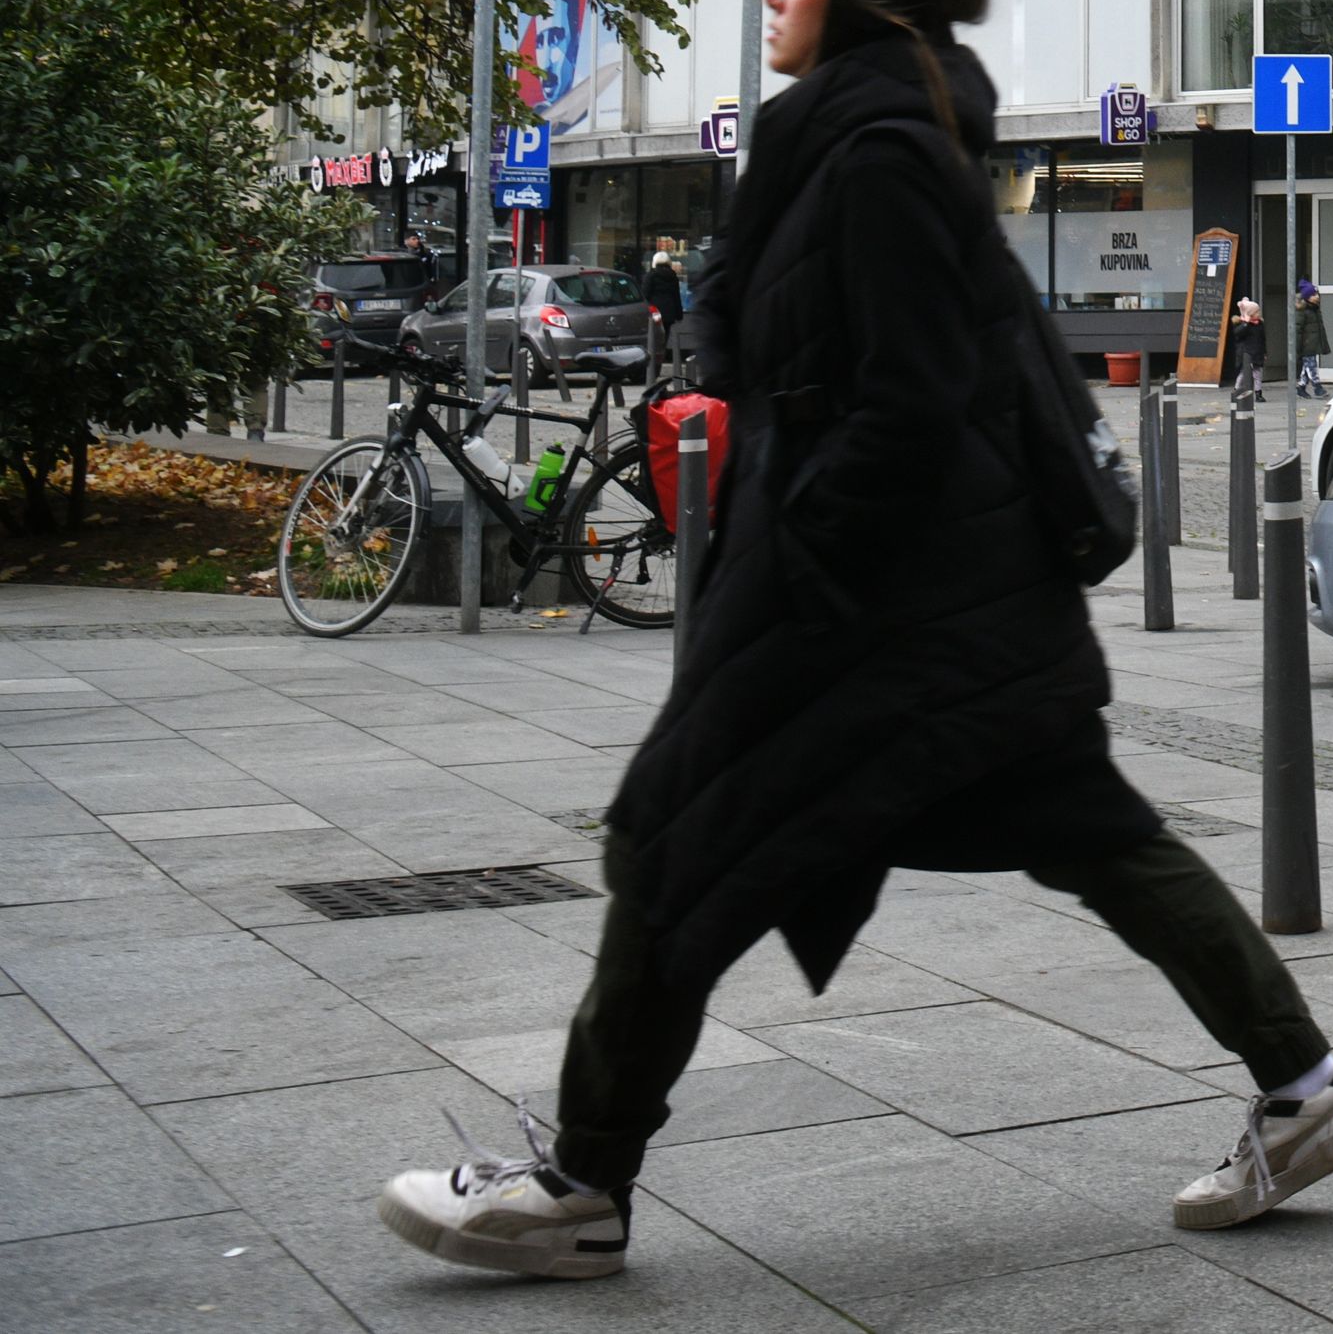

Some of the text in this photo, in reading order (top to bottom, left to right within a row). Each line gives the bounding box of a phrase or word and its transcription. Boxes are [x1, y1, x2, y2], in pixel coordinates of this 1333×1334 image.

[1114, 116, 1143, 128] SHOP
[1117, 128, 1140, 141] &GO
[514, 124, 541, 163] P
[324, 152, 372, 187] MAXBET
[1112, 232, 1138, 249] BRZA
[1100, 253, 1152, 271] KUPOVINA.
